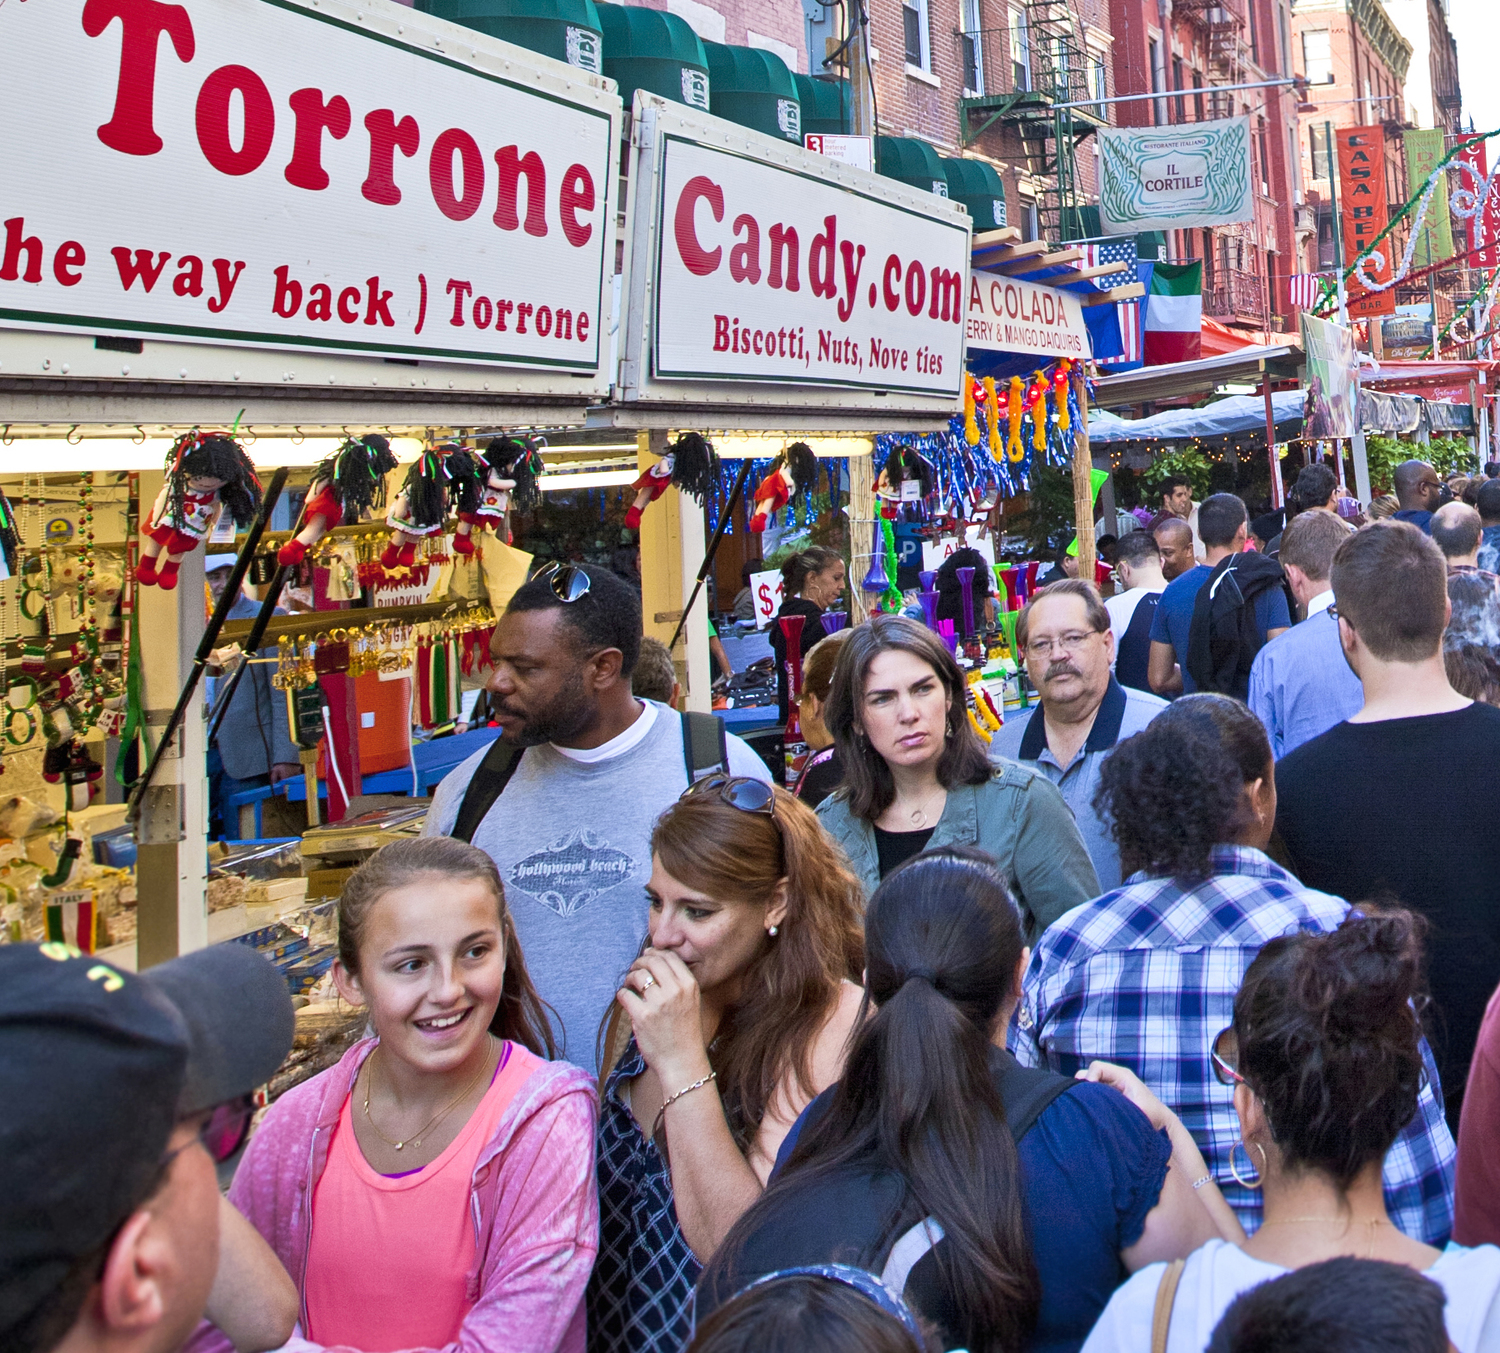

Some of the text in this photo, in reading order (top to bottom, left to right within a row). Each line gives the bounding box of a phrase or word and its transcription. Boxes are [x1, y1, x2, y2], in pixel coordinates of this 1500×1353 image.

[809, 137, 821, 154] 3
[1143, 138, 1207, 149] RISTORANTE ITALIANO
[1166, 164, 1180, 176] IL
[1348, 133, 1372, 195] CASA
[1145, 176, 1204, 192] CORTILE
[674, 175, 962, 322] Candy.com
[111, 245, 246, 313] way
[273, 265, 395, 327] back
[446, 278, 590, 342] Torrone
[990, 280, 1069, 328] COLADA
[1360, 300, 1383, 309] BAR
[713, 314, 810, 370] Biscotti,
[817, 326, 863, 374] Nuts,
[914, 342, 943, 375] ties
[996, 323, 1003, 343] &
[1004, 324, 1039, 347] MANGO
[1039, 329, 1082, 352] DAIQUIRIS
[518, 857, 628, 880] hollywood beach
[53, 893, 85, 904] ITALY
